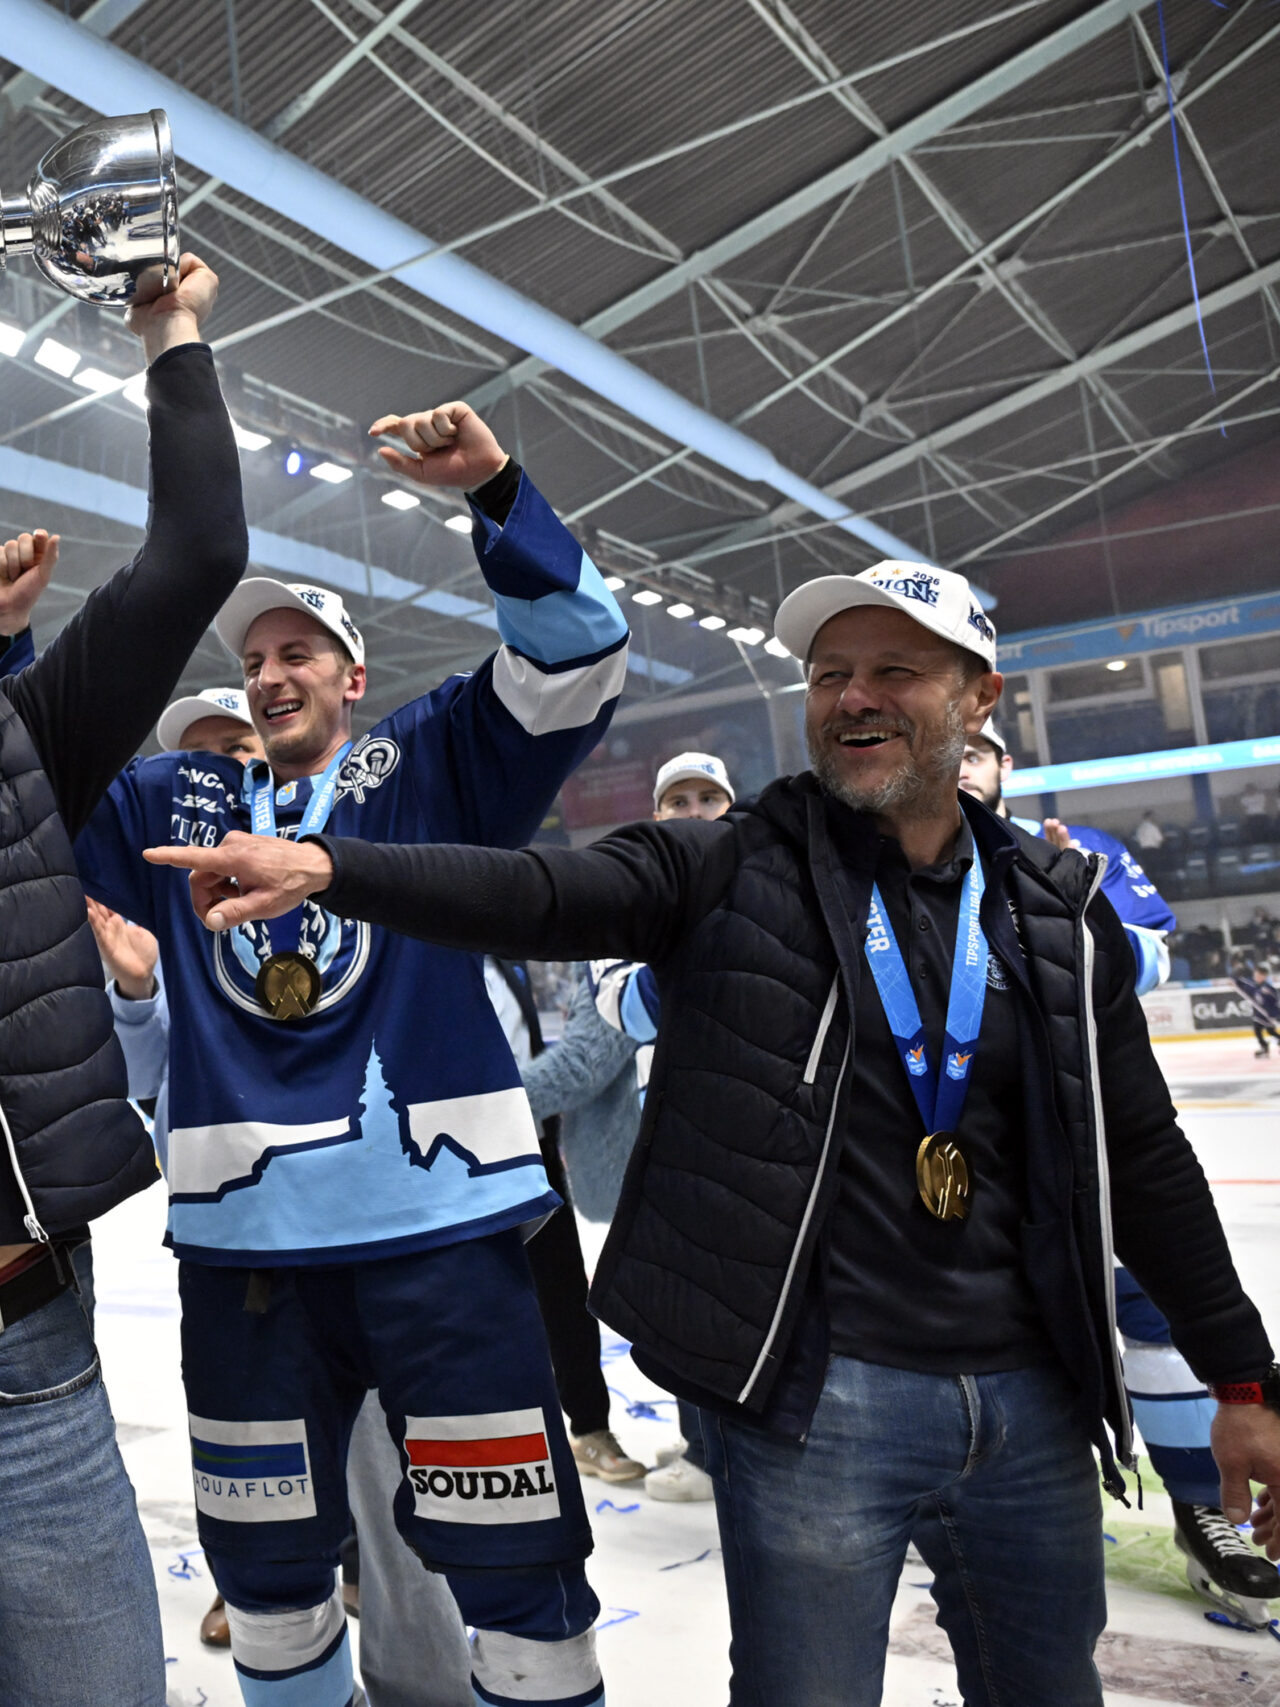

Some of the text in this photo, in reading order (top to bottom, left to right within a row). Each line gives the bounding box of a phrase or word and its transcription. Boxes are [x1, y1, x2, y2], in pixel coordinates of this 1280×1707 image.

[912, 570, 941, 586] 2026
[1140, 606, 1242, 640] Tipsport
[969, 890, 982, 915] LIGA
[966, 915, 981, 967] TIPSPORT
[195, 1477, 309, 1498] AQUAFLOT
[410, 1465, 554, 1501] SOUDAL
